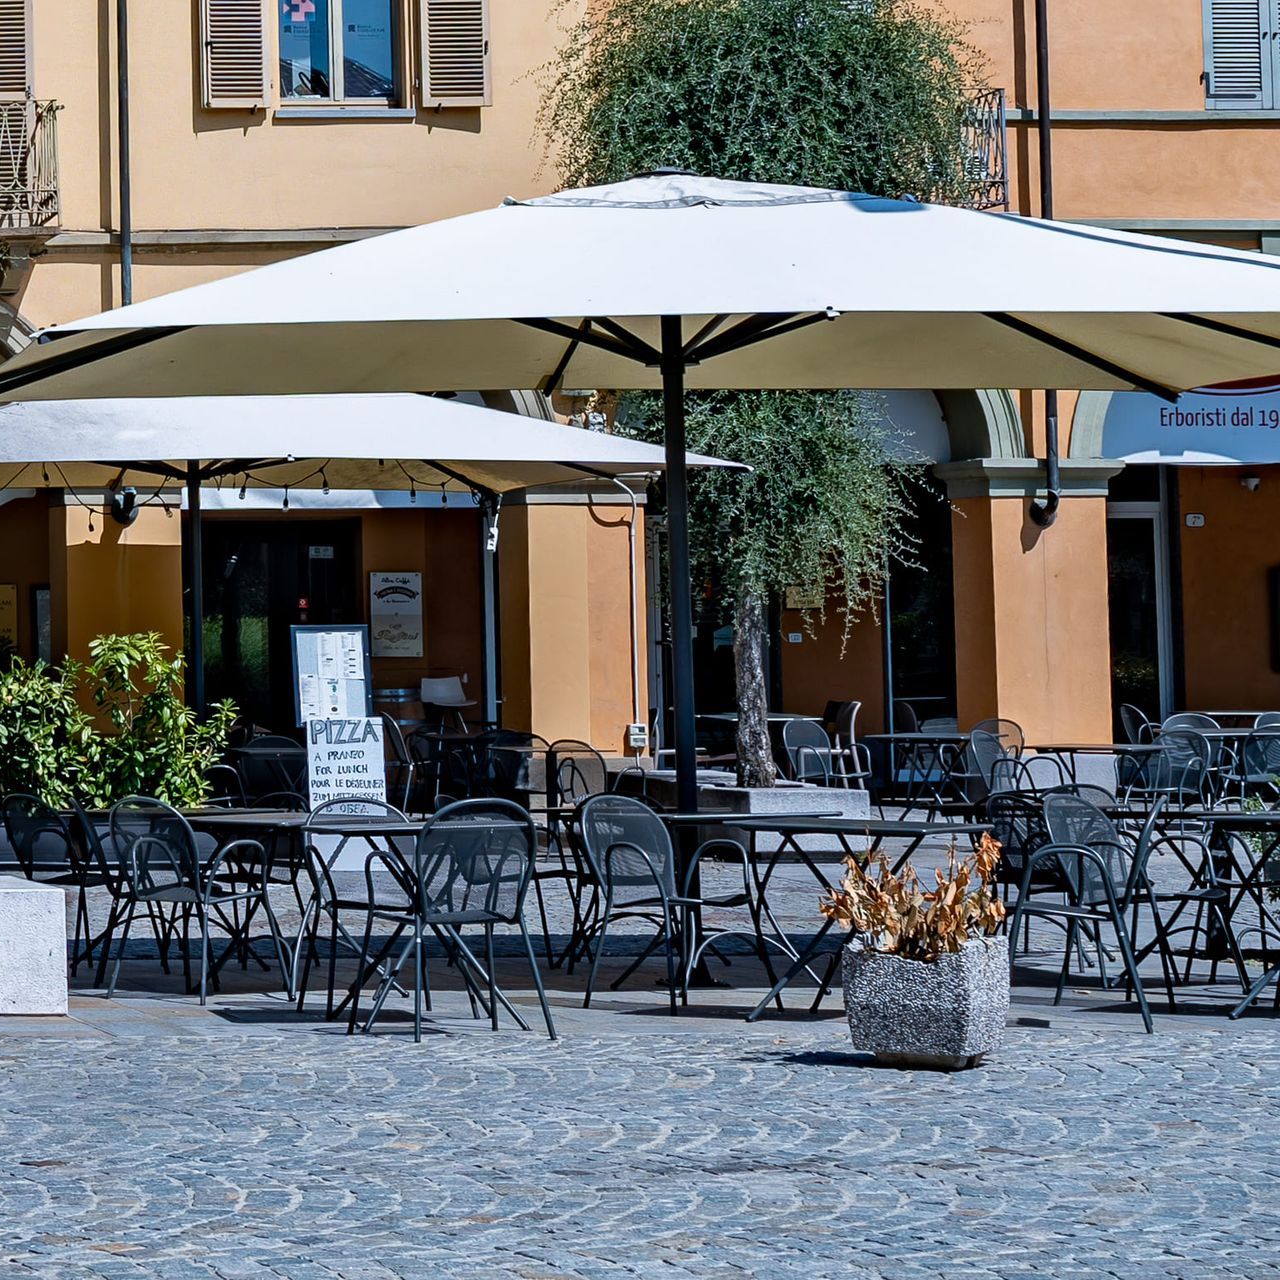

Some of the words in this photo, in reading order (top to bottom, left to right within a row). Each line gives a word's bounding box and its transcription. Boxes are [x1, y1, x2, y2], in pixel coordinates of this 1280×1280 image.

[1160, 407, 1226, 426] Erboristi
[1231, 406, 1253, 426] dal
[314, 753, 321, 761] A
[327, 750, 364, 760] PRANZO
[315, 765, 332, 775] FOR
[337, 764, 368, 774] LUNCH
[311, 779, 330, 788] POUR
[335, 779, 344, 787] LE
